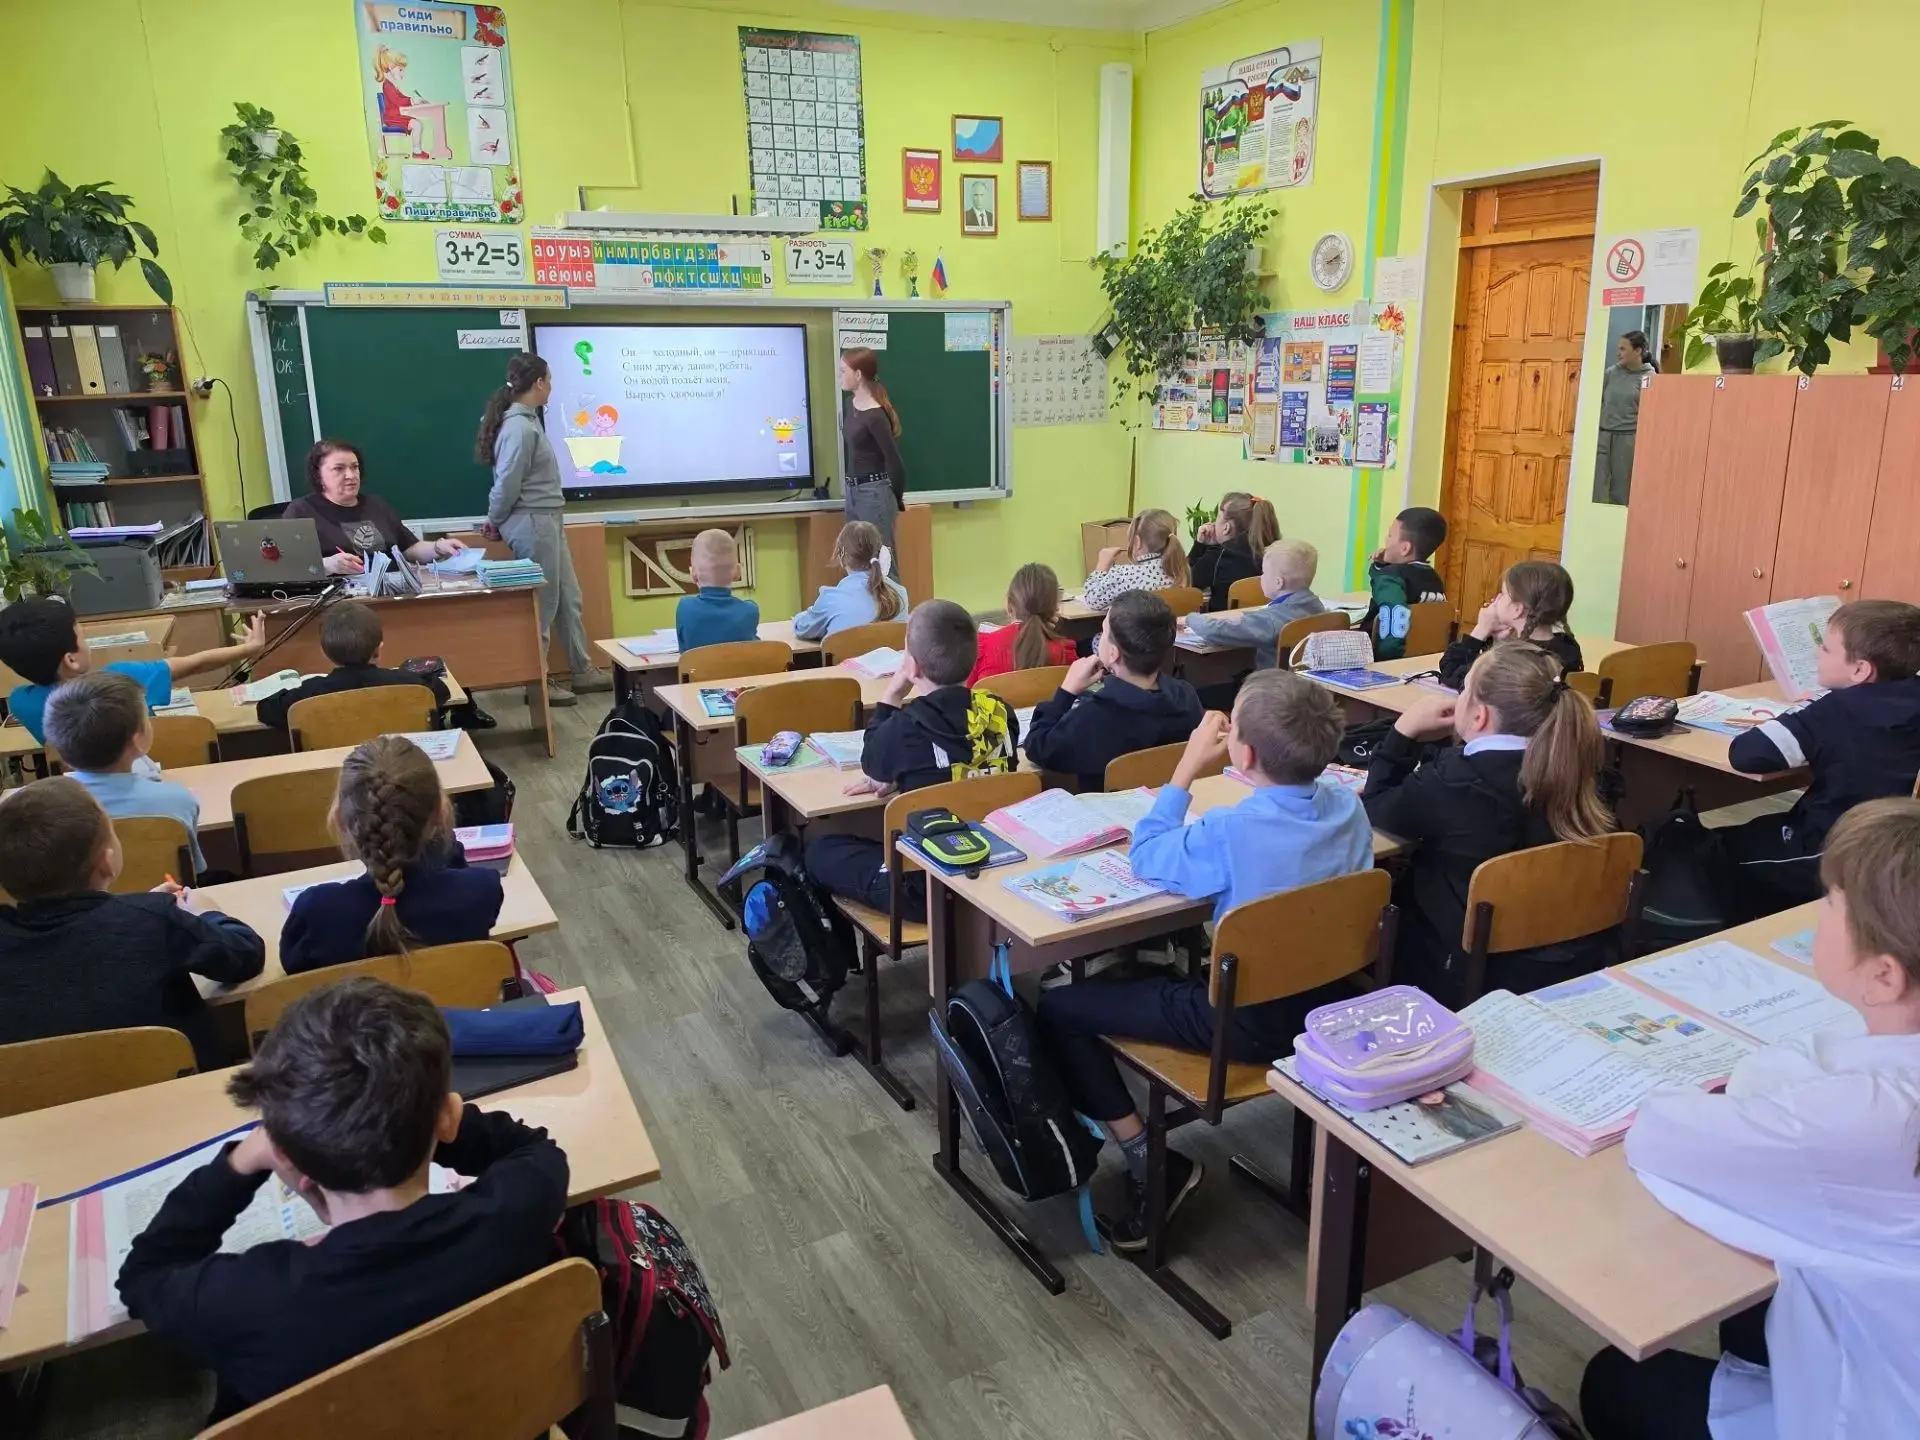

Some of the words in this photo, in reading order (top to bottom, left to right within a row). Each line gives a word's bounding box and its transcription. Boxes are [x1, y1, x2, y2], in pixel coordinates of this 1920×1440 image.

[398, 8, 432, 21] Сиди
[380, 20, 453, 35] правильно
[404, 206, 436, 217] Пиши
[439, 209, 497, 219] правильно
[449, 231, 482, 239] СУММА
[789, 240, 827, 248] РАЗНОСТЬ
[445, 240, 520, 267] 3+2=5
[503, 312, 518, 324] 15
[1294, 316, 1315, 328] НАШ
[1318, 313, 1350, 327] КЛАСС
[621, 347, 636, 356] Он
[624, 376, 638, 385] Он
[641, 376, 669, 385] водой
[1643, 376, 1650, 388] 1
[1716, 377, 1724, 389] 2
[1800, 376, 1808, 389] 3
[1893, 376, 1902, 390] 4
[1718, 988, 1800, 1019] Сертификат
